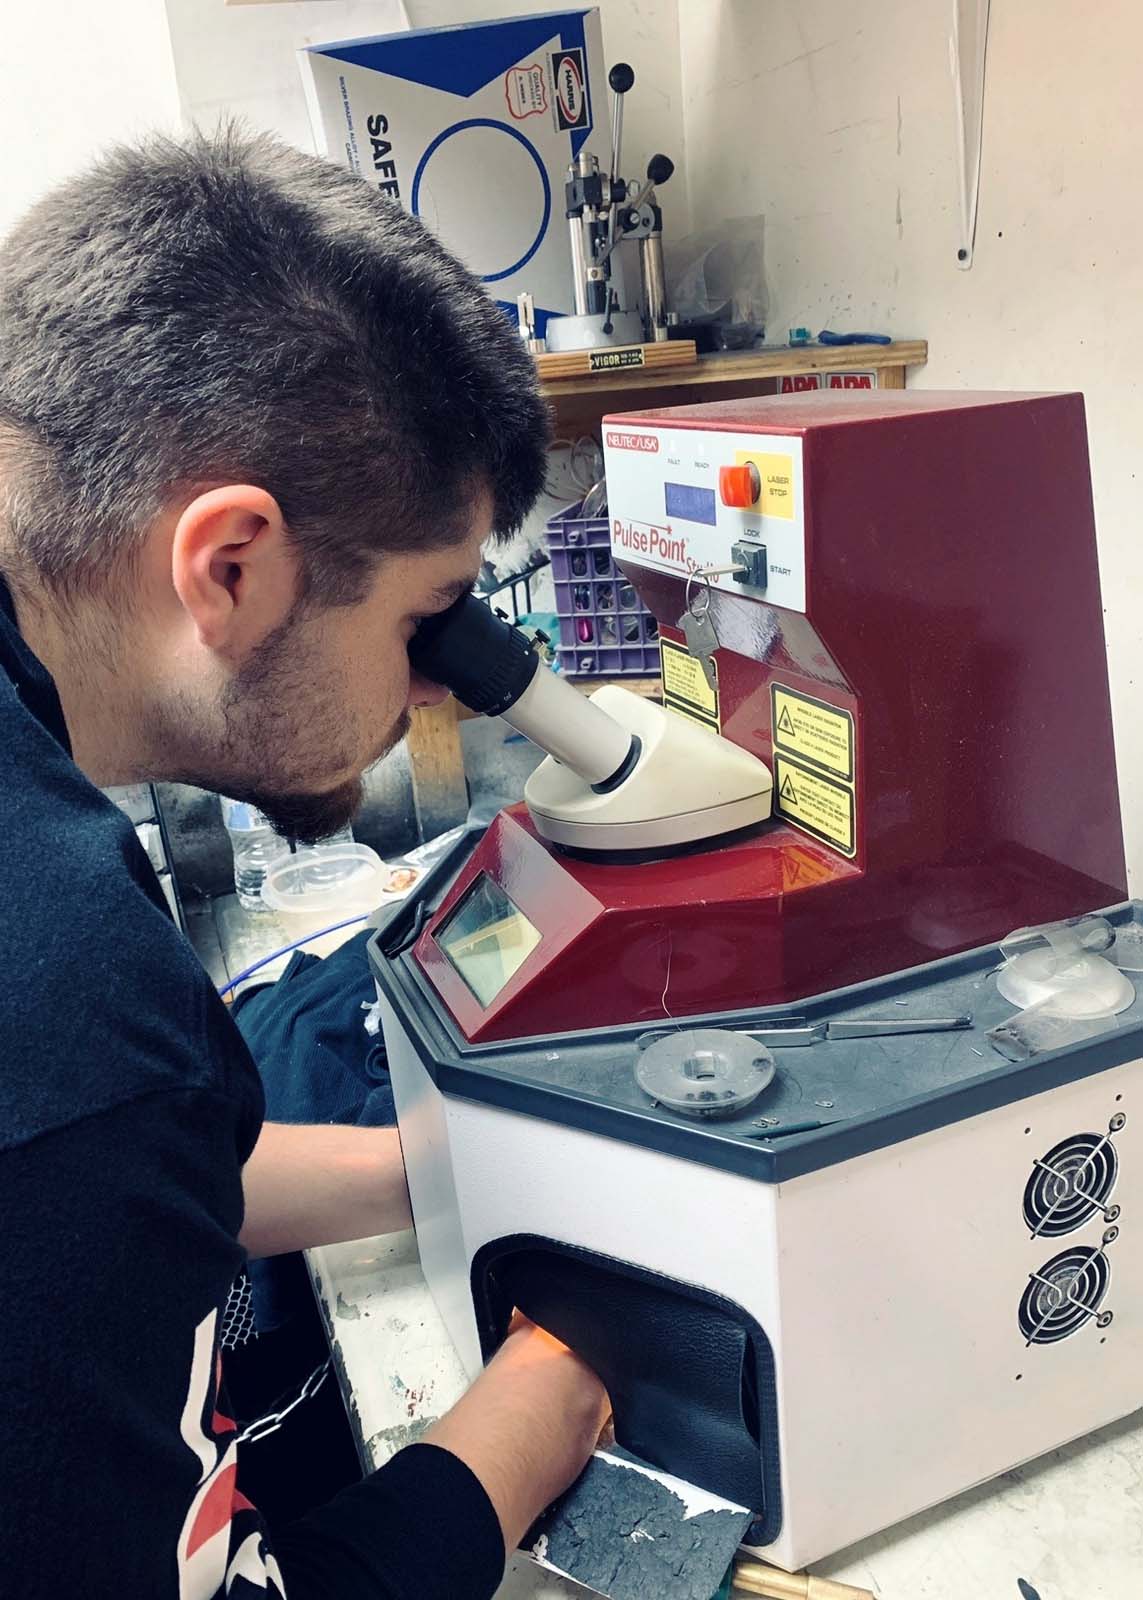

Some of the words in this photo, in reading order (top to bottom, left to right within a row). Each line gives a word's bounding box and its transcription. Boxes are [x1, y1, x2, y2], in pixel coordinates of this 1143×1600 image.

[533, 72, 542, 106] QUALITY
[565, 69, 576, 111] HARRIS
[344, 101, 353, 131] BRAZING
[350, 132, 358, 153] ALLOY
[594, 354, 620, 367] VIGOR
[767, 475, 790, 485] LASER
[769, 487, 788, 497] STOP
[743, 528, 761, 539] LOCK
[769, 564, 792, 577] START
